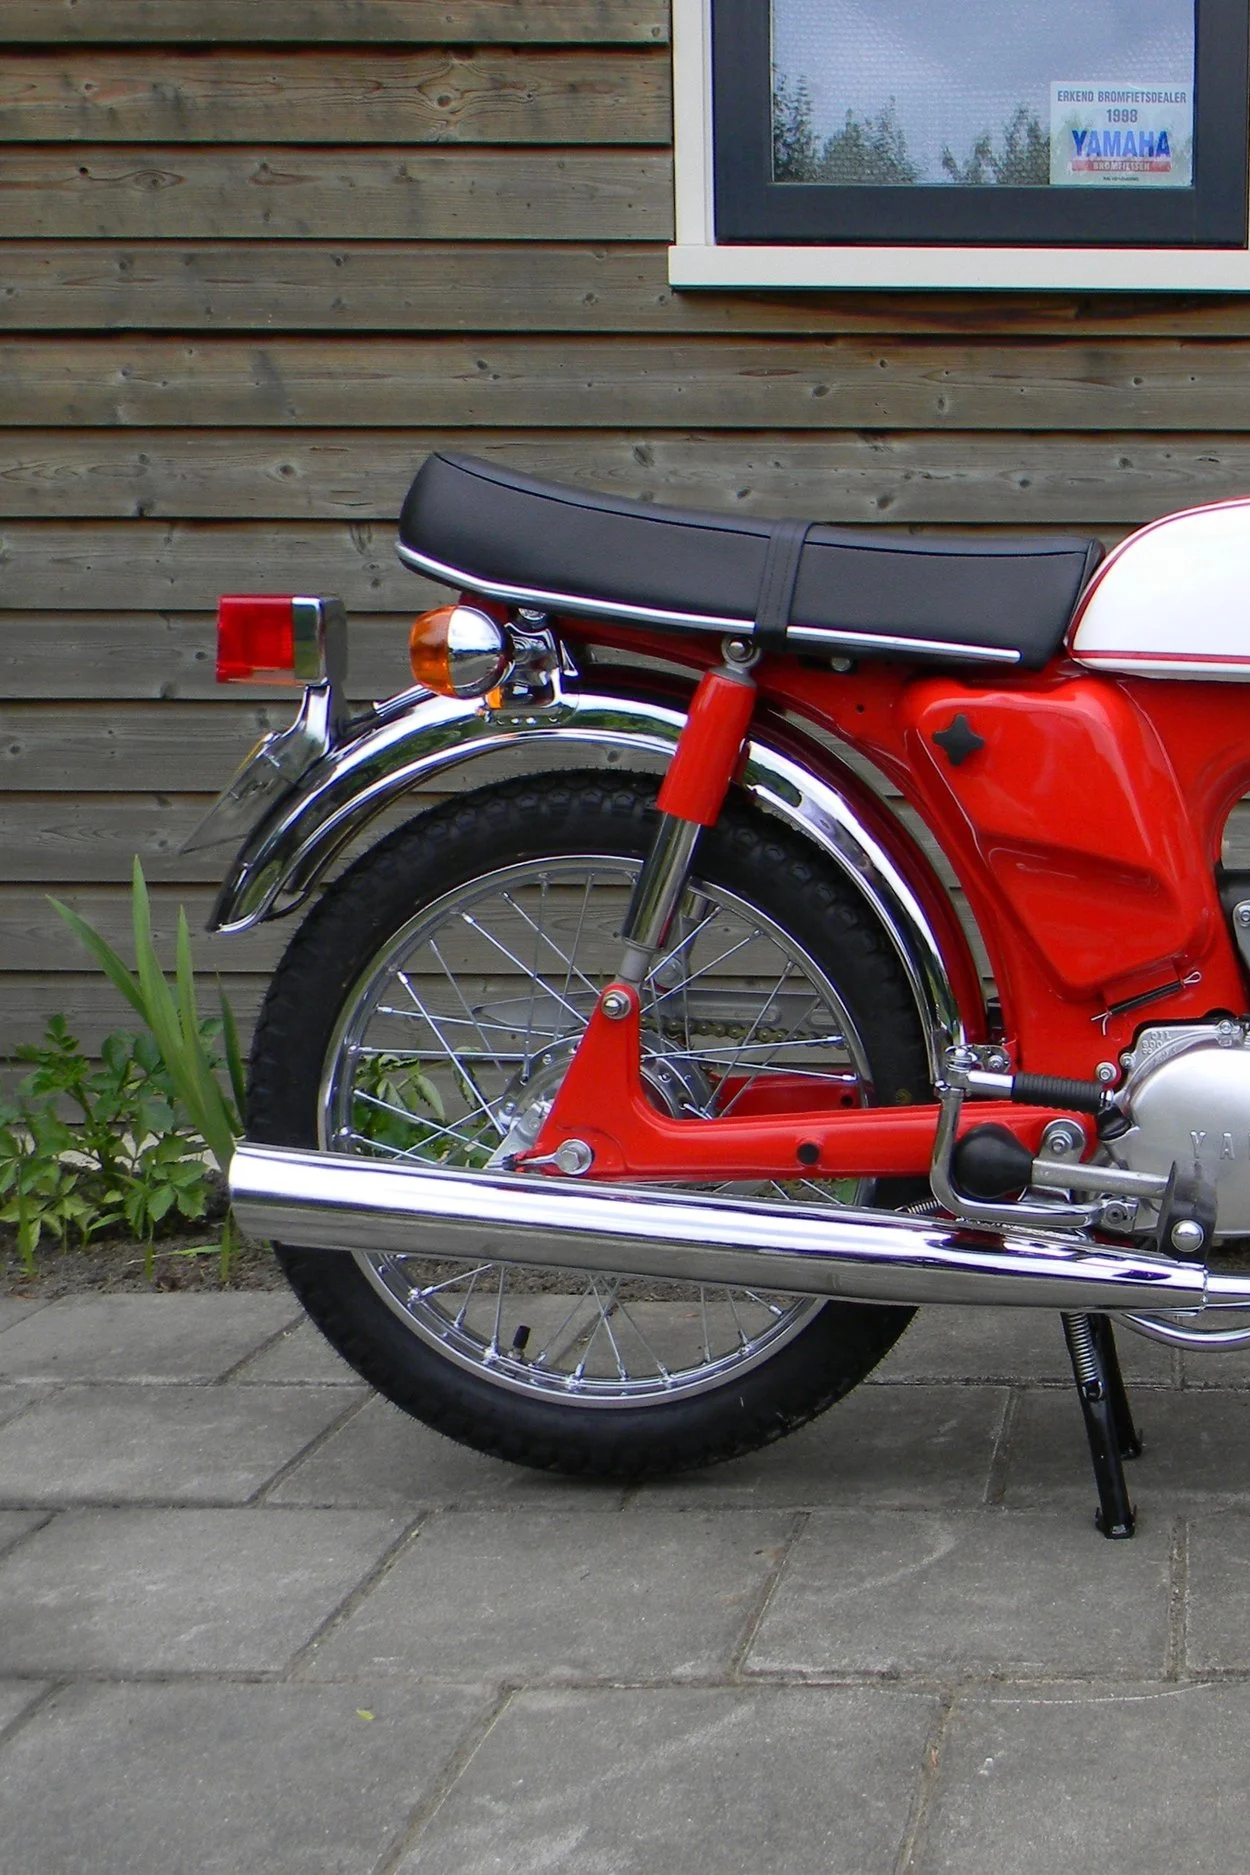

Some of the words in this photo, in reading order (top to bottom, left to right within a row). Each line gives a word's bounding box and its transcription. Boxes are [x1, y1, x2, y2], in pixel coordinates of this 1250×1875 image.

[1057, 90, 1094, 102] ERKEND
[1097, 91, 1187, 104] BROMFIETSDEALER
[1106, 109, 1138, 123] 1998
[1071, 130, 1171, 157] YAMAHA
